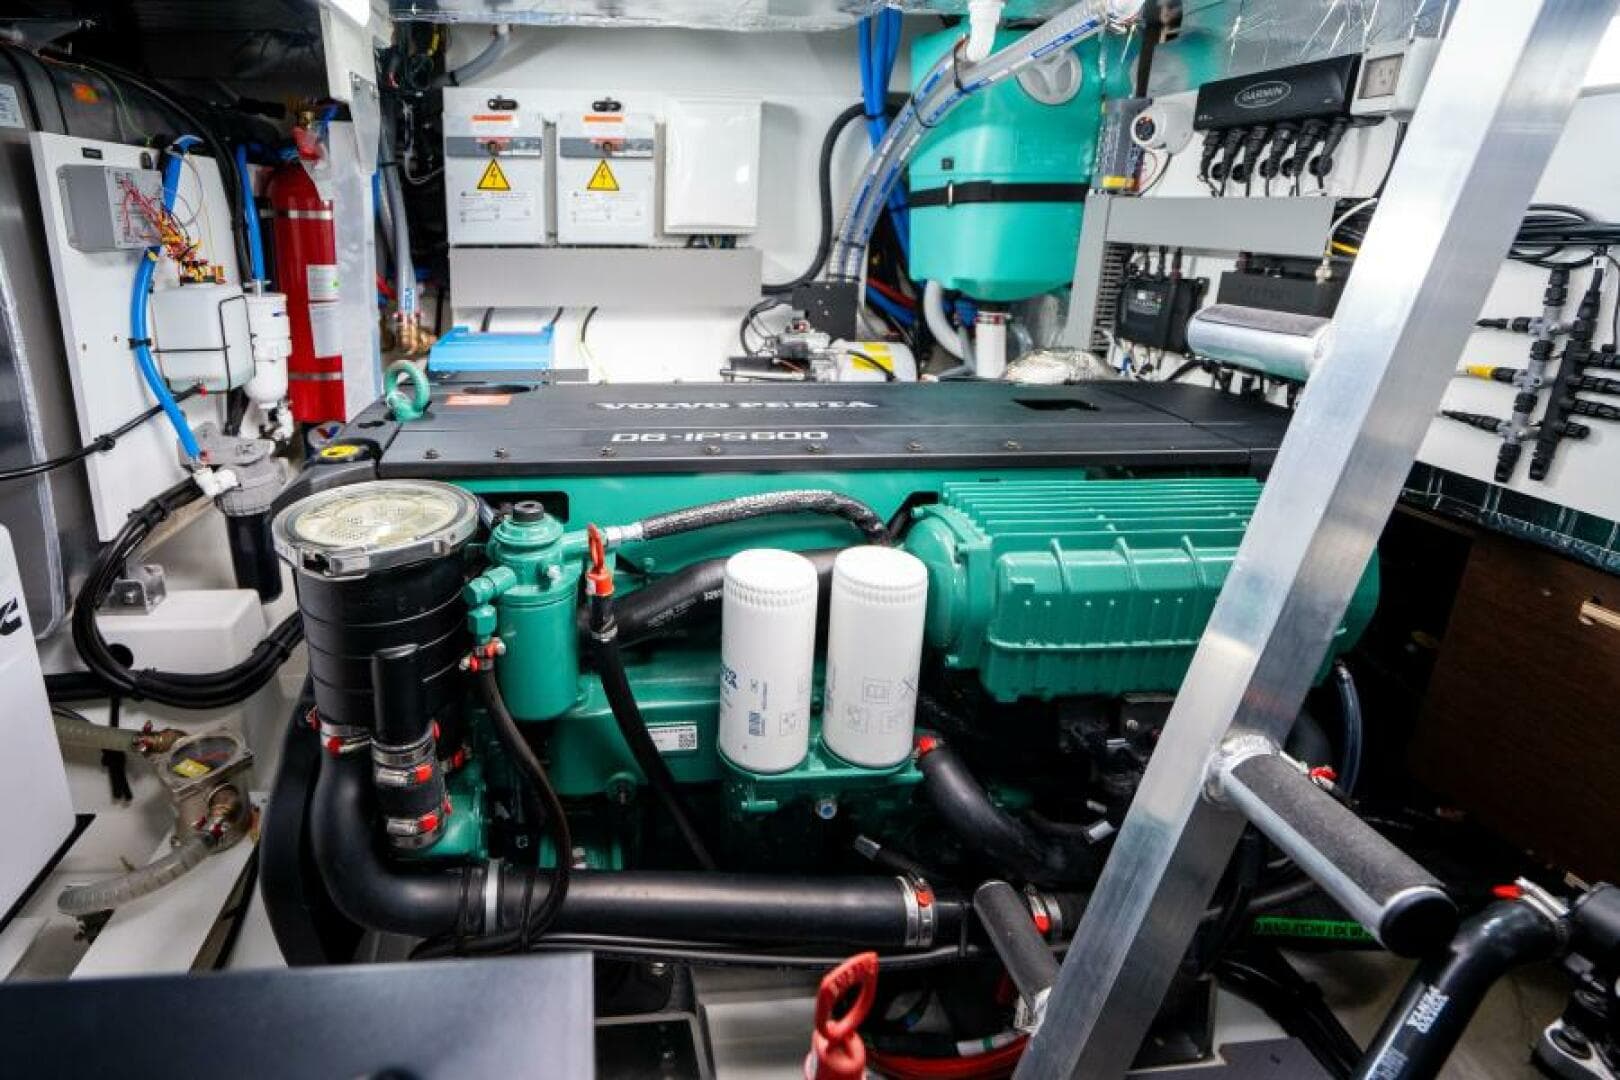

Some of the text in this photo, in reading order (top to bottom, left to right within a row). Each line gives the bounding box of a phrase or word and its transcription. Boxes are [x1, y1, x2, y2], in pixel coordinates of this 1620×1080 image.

[1240, 86, 1283, 101] GARMIN
[596, 400, 879, 410] VOLVO PENTA
[611, 431, 829, 442] D6-IPS600
